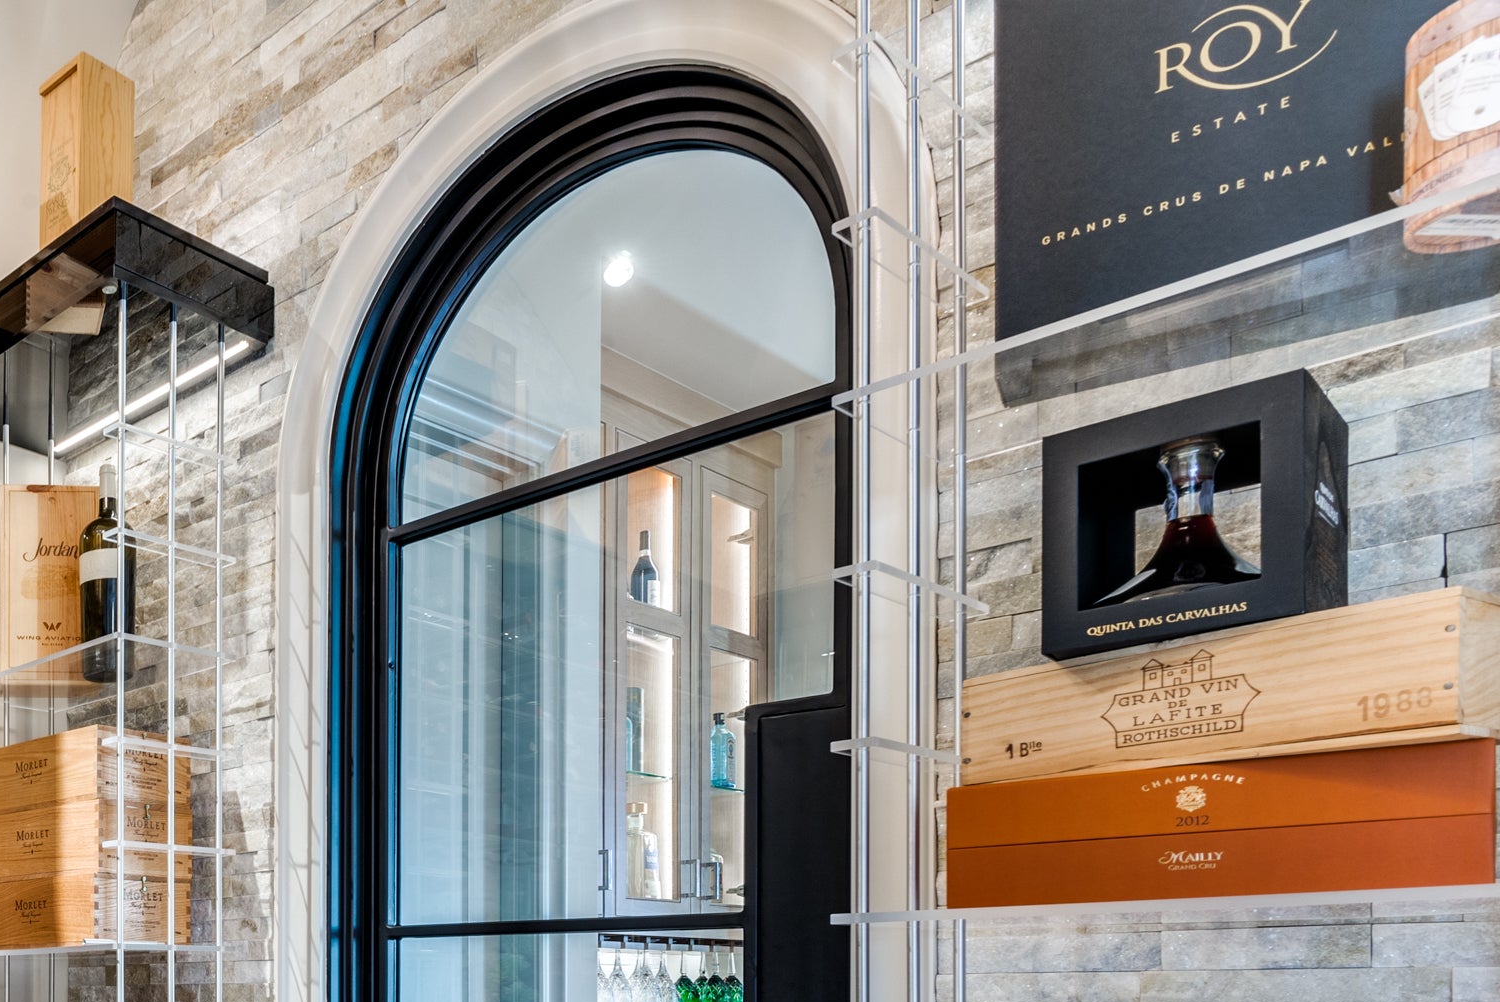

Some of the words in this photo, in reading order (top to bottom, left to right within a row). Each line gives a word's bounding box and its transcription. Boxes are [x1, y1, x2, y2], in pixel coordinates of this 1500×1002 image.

[1154, 0, 1338, 93] ROY
[1171, 96, 1291, 143] ESTATE
[1041, 212, 1128, 246] GRANDS
[1142, 191, 1202, 216] CRUS
[1218, 177, 1248, 195] DE
[1263, 154, 1329, 182] NAPA
[22, 537, 80, 563] Jordan
[1086, 620, 1136, 637] QUINTA
[1138, 615, 1163, 628] DAS
[1165, 601, 1248, 624] CARVALHAS
[1117, 686, 1192, 708] GRAND
[1201, 678, 1239, 694] VIN
[1167, 699, 1188, 709] DE
[1132, 703, 1223, 727] LAFITE
[1122, 719, 1237, 745] ROTHSCHILD
[1004, 742, 1014, 760] 1
[15, 758, 49, 773] MORLET
[1140, 772, 1246, 792] CHAMPAGNE
[126, 815, 166, 831] MORLET
[1175, 815, 1210, 827] 2012
[16, 829, 50, 842] MORLET
[15, 899, 48, 911] MORLET
[123, 888, 164, 902] MORLET
